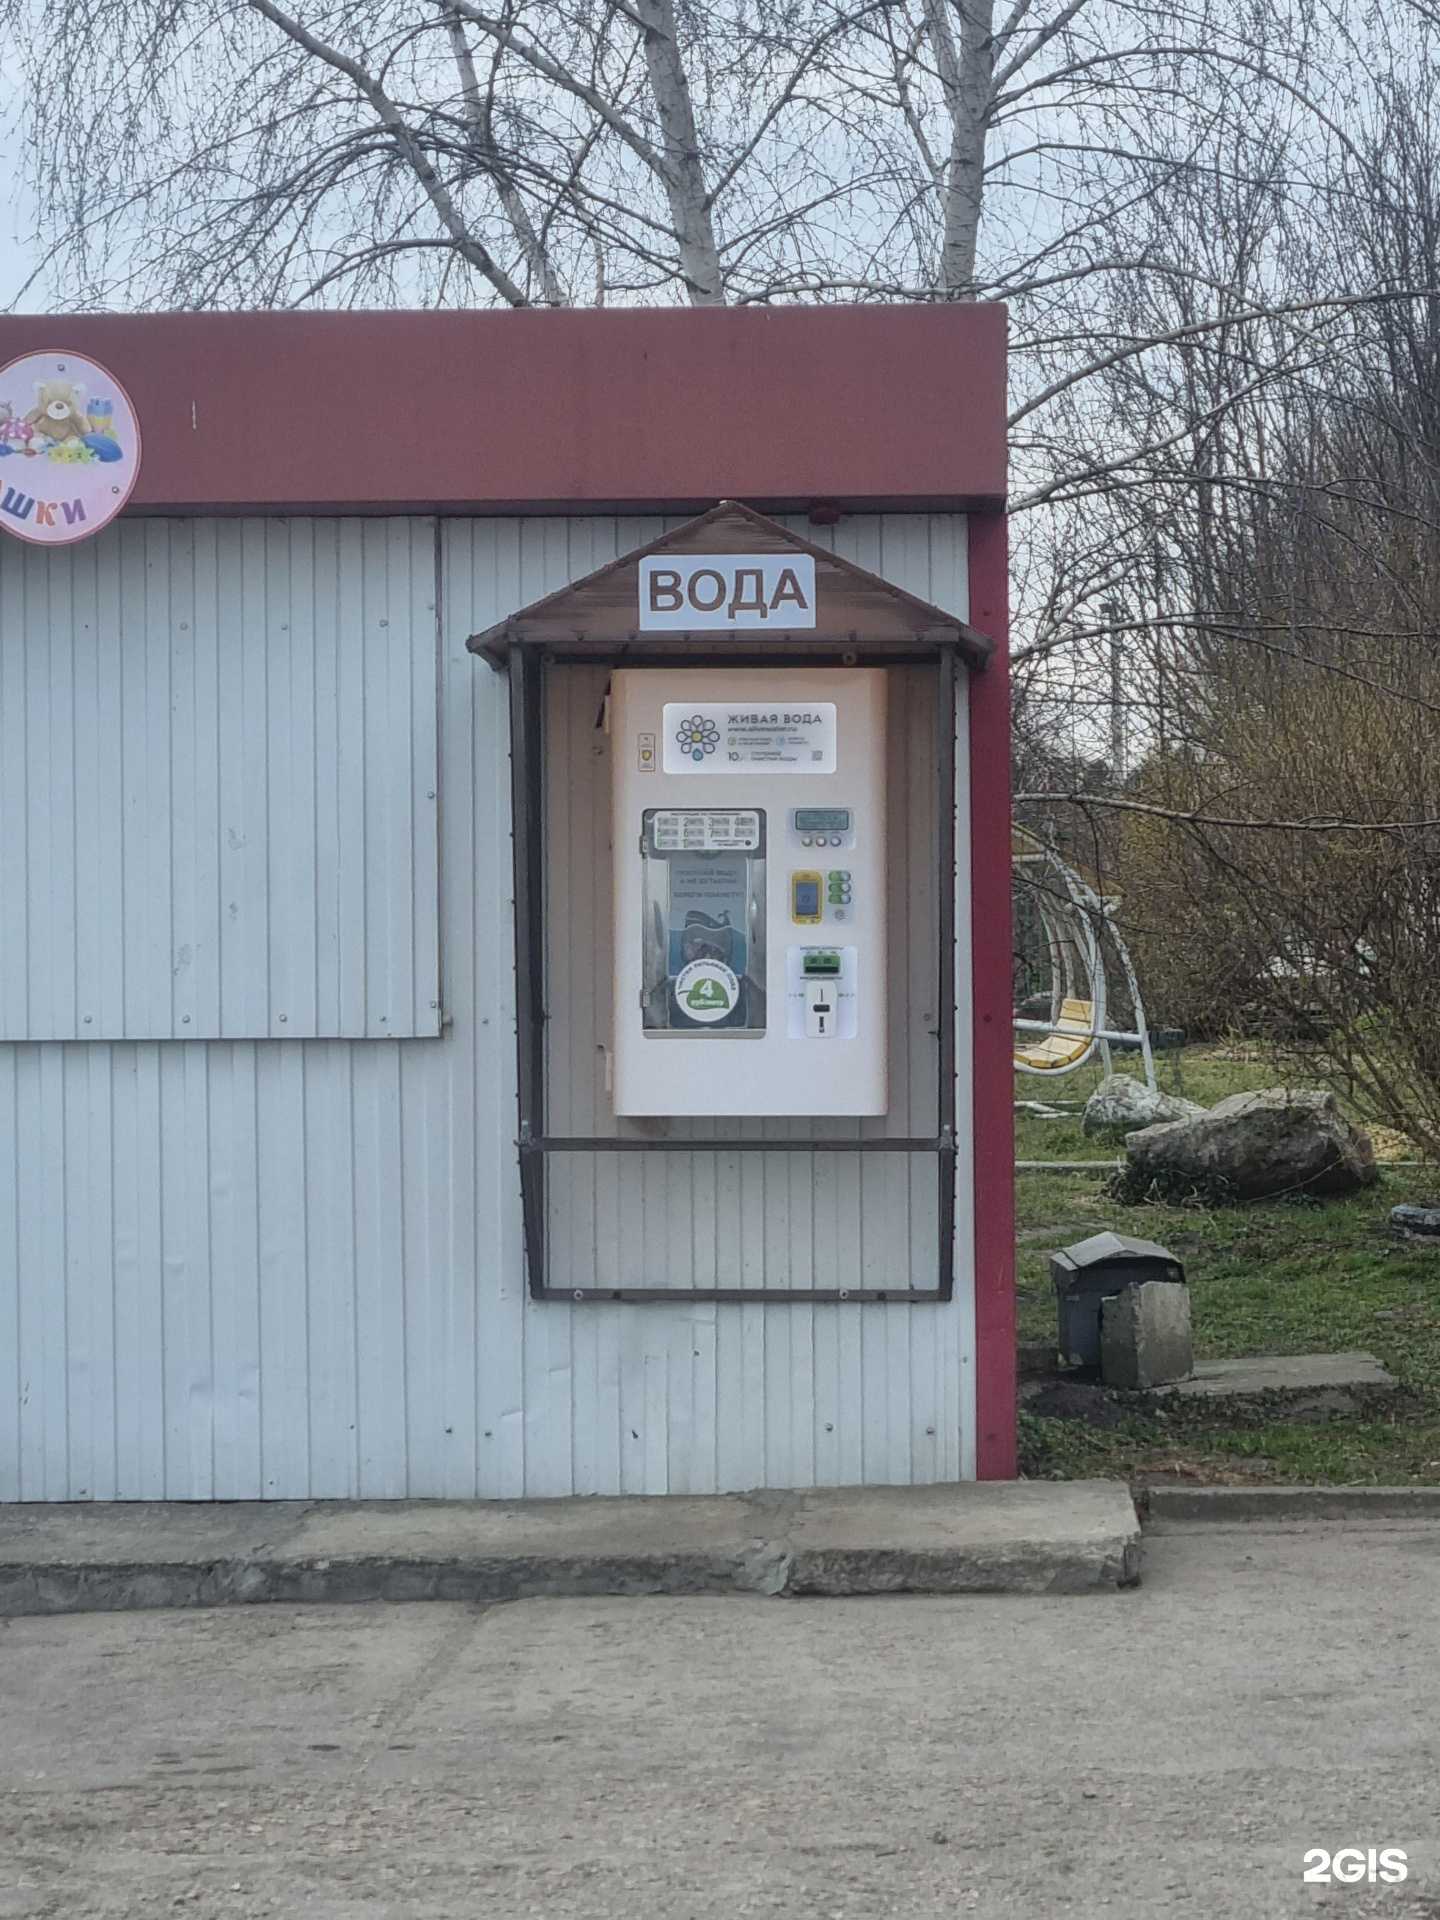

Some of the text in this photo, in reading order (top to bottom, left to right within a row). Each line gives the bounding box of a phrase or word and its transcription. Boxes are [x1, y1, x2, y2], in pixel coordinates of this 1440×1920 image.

[649, 568, 809, 619] ВОДА
[727, 713, 823, 725] ЖИВАЯ ВОДА
[699, 979, 714, 999] 4
